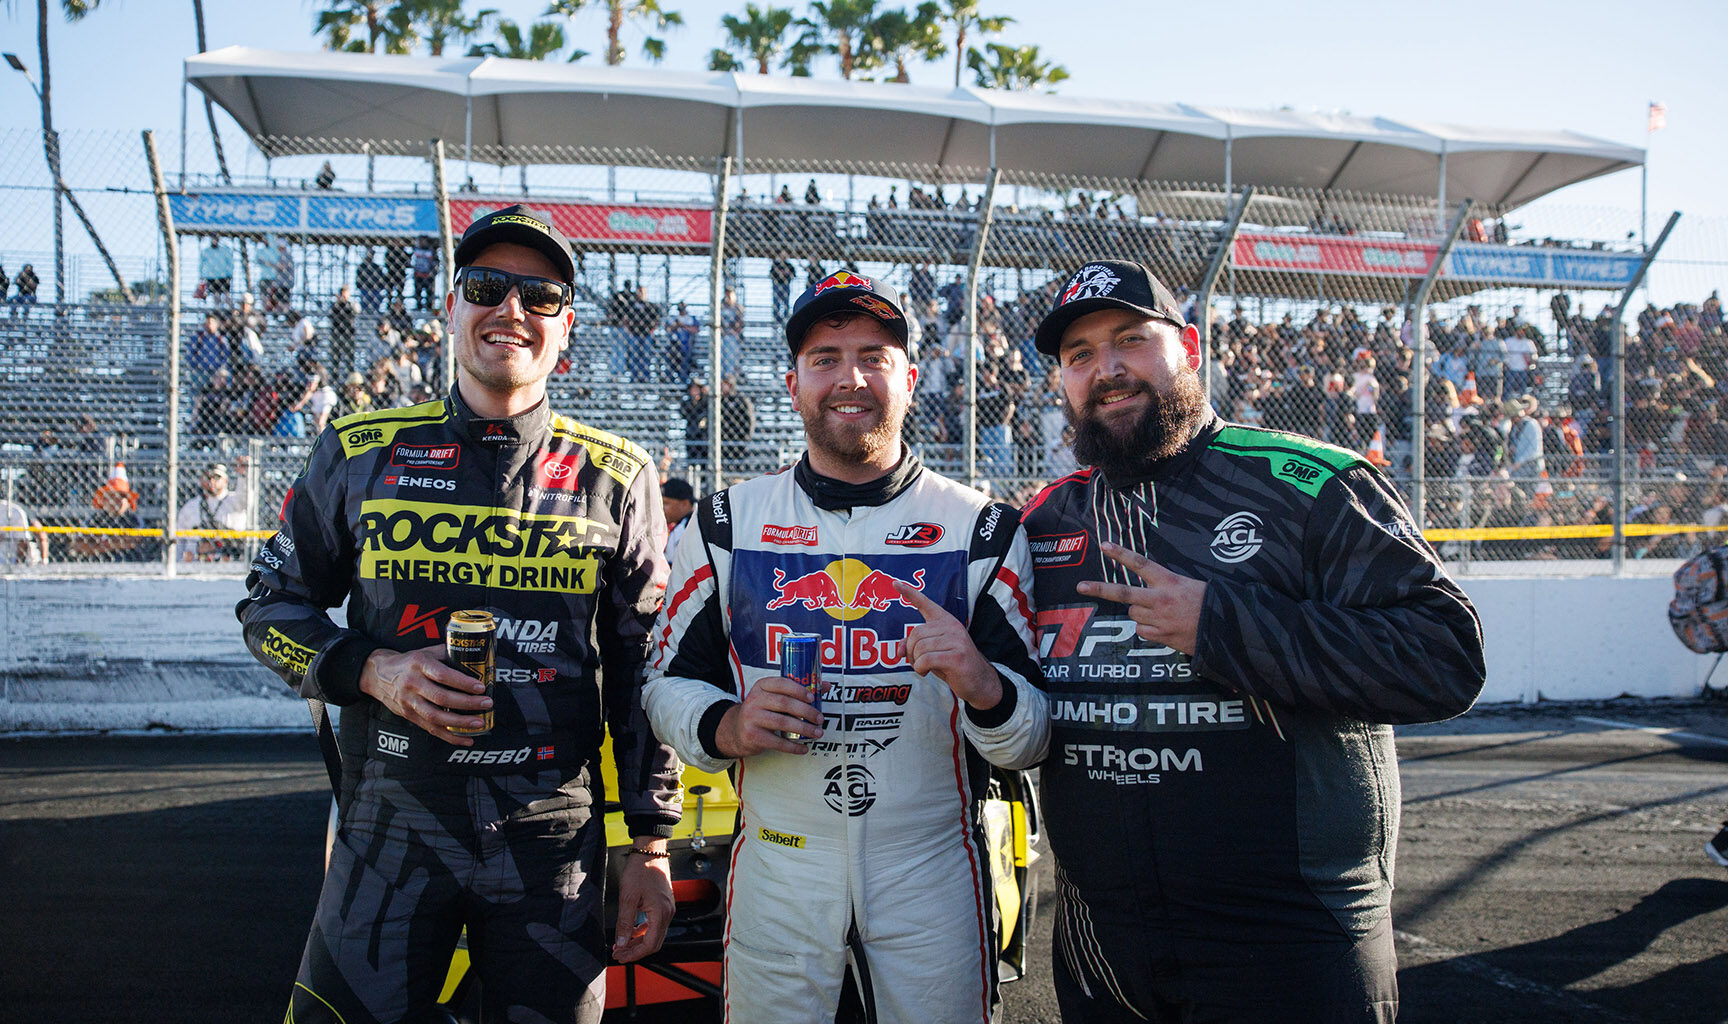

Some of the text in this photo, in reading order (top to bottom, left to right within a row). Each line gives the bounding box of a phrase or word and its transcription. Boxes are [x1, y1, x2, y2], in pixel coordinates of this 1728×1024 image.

[348, 432, 383, 444] OMP
[396, 447, 456, 458] FORMULA DRIFT
[601, 454, 632, 473] OMP
[1282, 462, 1319, 481] OMP
[398, 476, 456, 490] ENEOS
[712, 491, 729, 524] Sabelt
[980, 504, 1002, 541] Sabelt
[360, 510, 611, 560] ROCKSTAR
[763, 527, 816, 541] FORMULA DRIFT
[1057, 537, 1084, 552] DRIFT
[375, 559, 586, 590] ENERGY DRINK
[516, 642, 556, 653] TIRES
[1078, 664, 1141, 678] TURBO
[1051, 700, 1245, 725] UMHO TIRE
[856, 719, 901, 727] RADIAL
[378, 735, 409, 753] OMP
[1064, 744, 1203, 771] STROM
[1088, 770, 1161, 785] WHEELS
[762, 829, 802, 847] Sabelt
